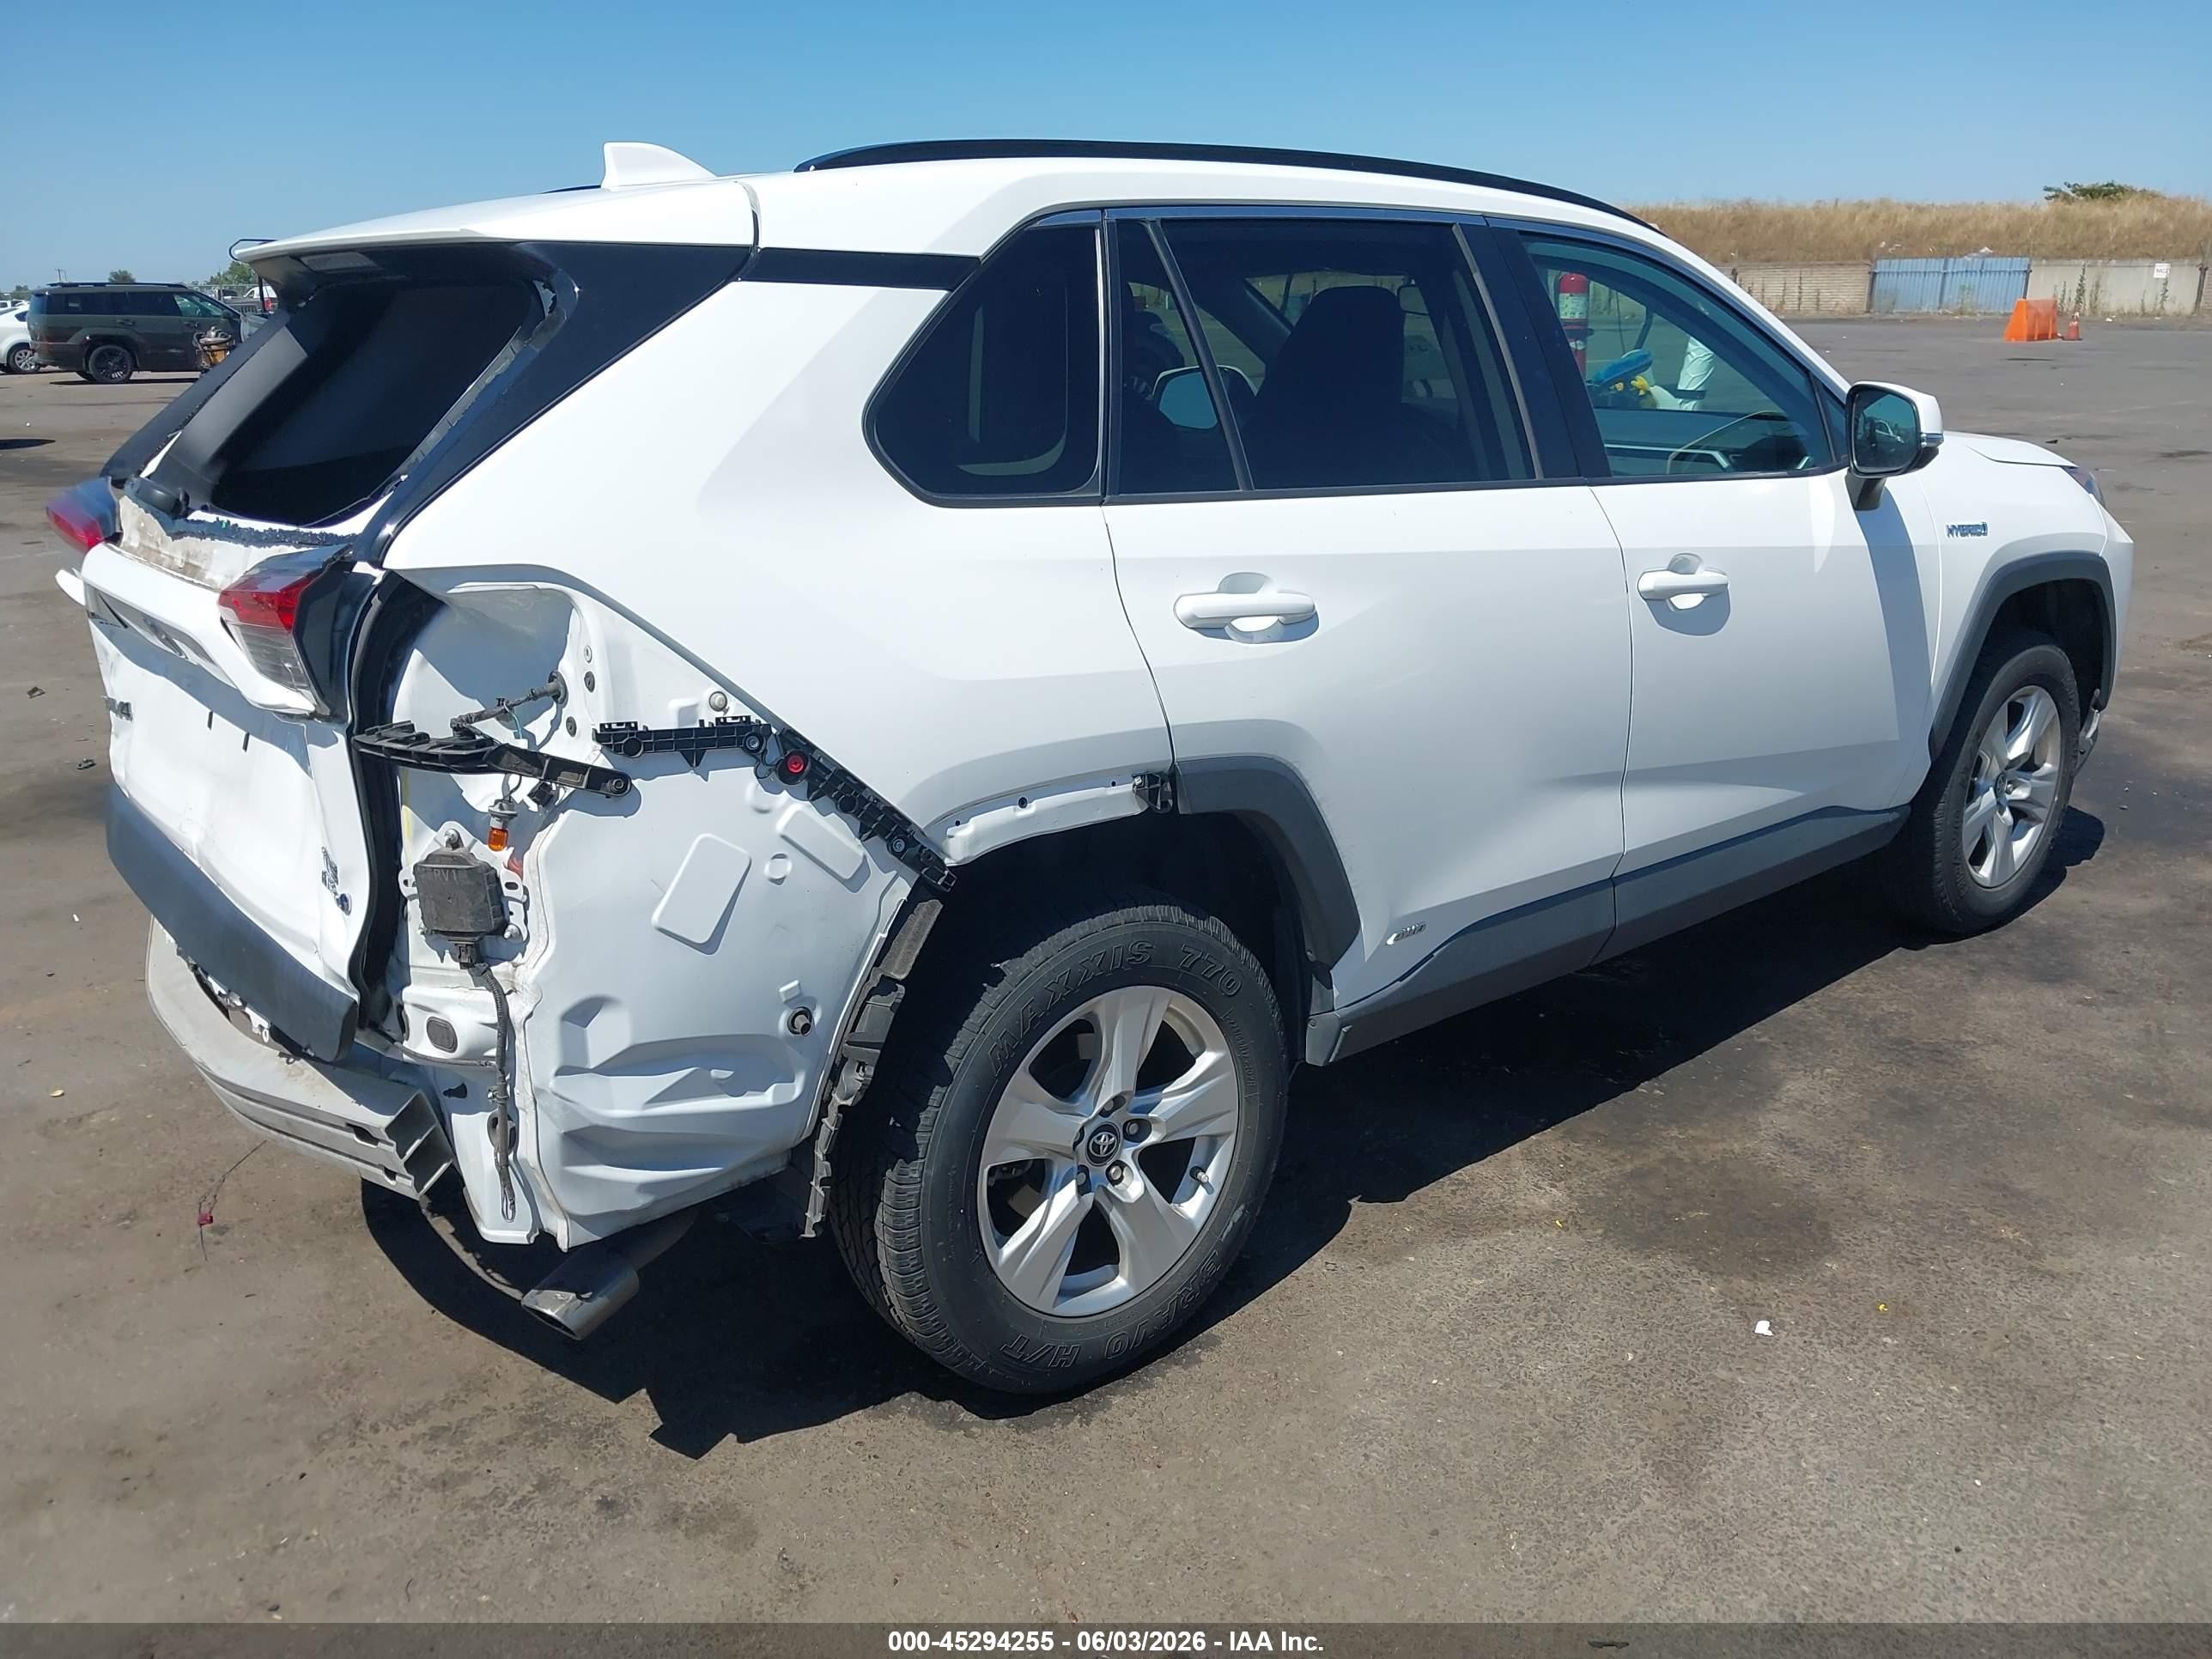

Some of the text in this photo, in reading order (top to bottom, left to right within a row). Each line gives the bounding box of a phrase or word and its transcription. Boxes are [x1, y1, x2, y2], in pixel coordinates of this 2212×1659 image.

[988, 939, 1156, 1077] MAXXIS
[1178, 943, 1243, 997] 770
[1000, 1332, 1082, 1369] H/T
